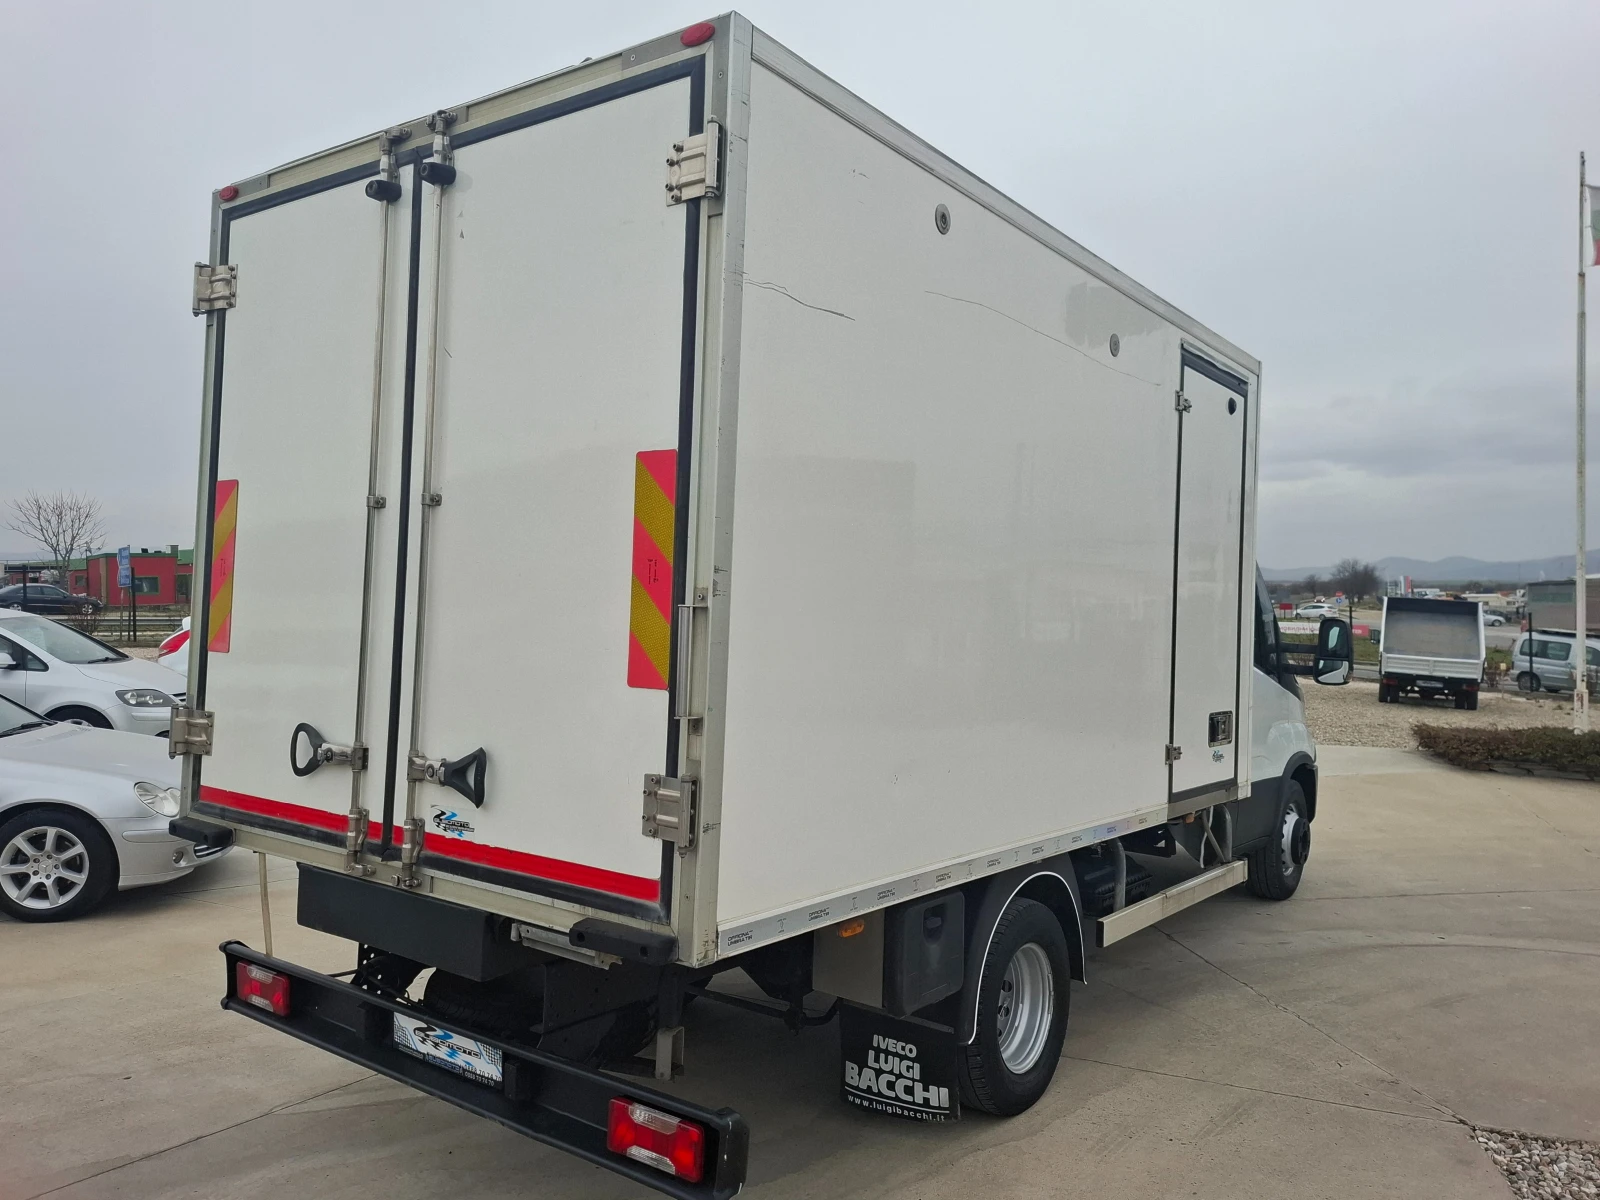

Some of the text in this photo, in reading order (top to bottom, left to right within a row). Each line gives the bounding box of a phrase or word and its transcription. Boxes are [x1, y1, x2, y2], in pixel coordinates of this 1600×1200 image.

[872, 1034, 917, 1058] IVECO
[867, 1050, 920, 1080] LUIGI
[845, 1060, 949, 1108] BACCHI
[847, 1094, 945, 1122] www.luigibacchi.it
